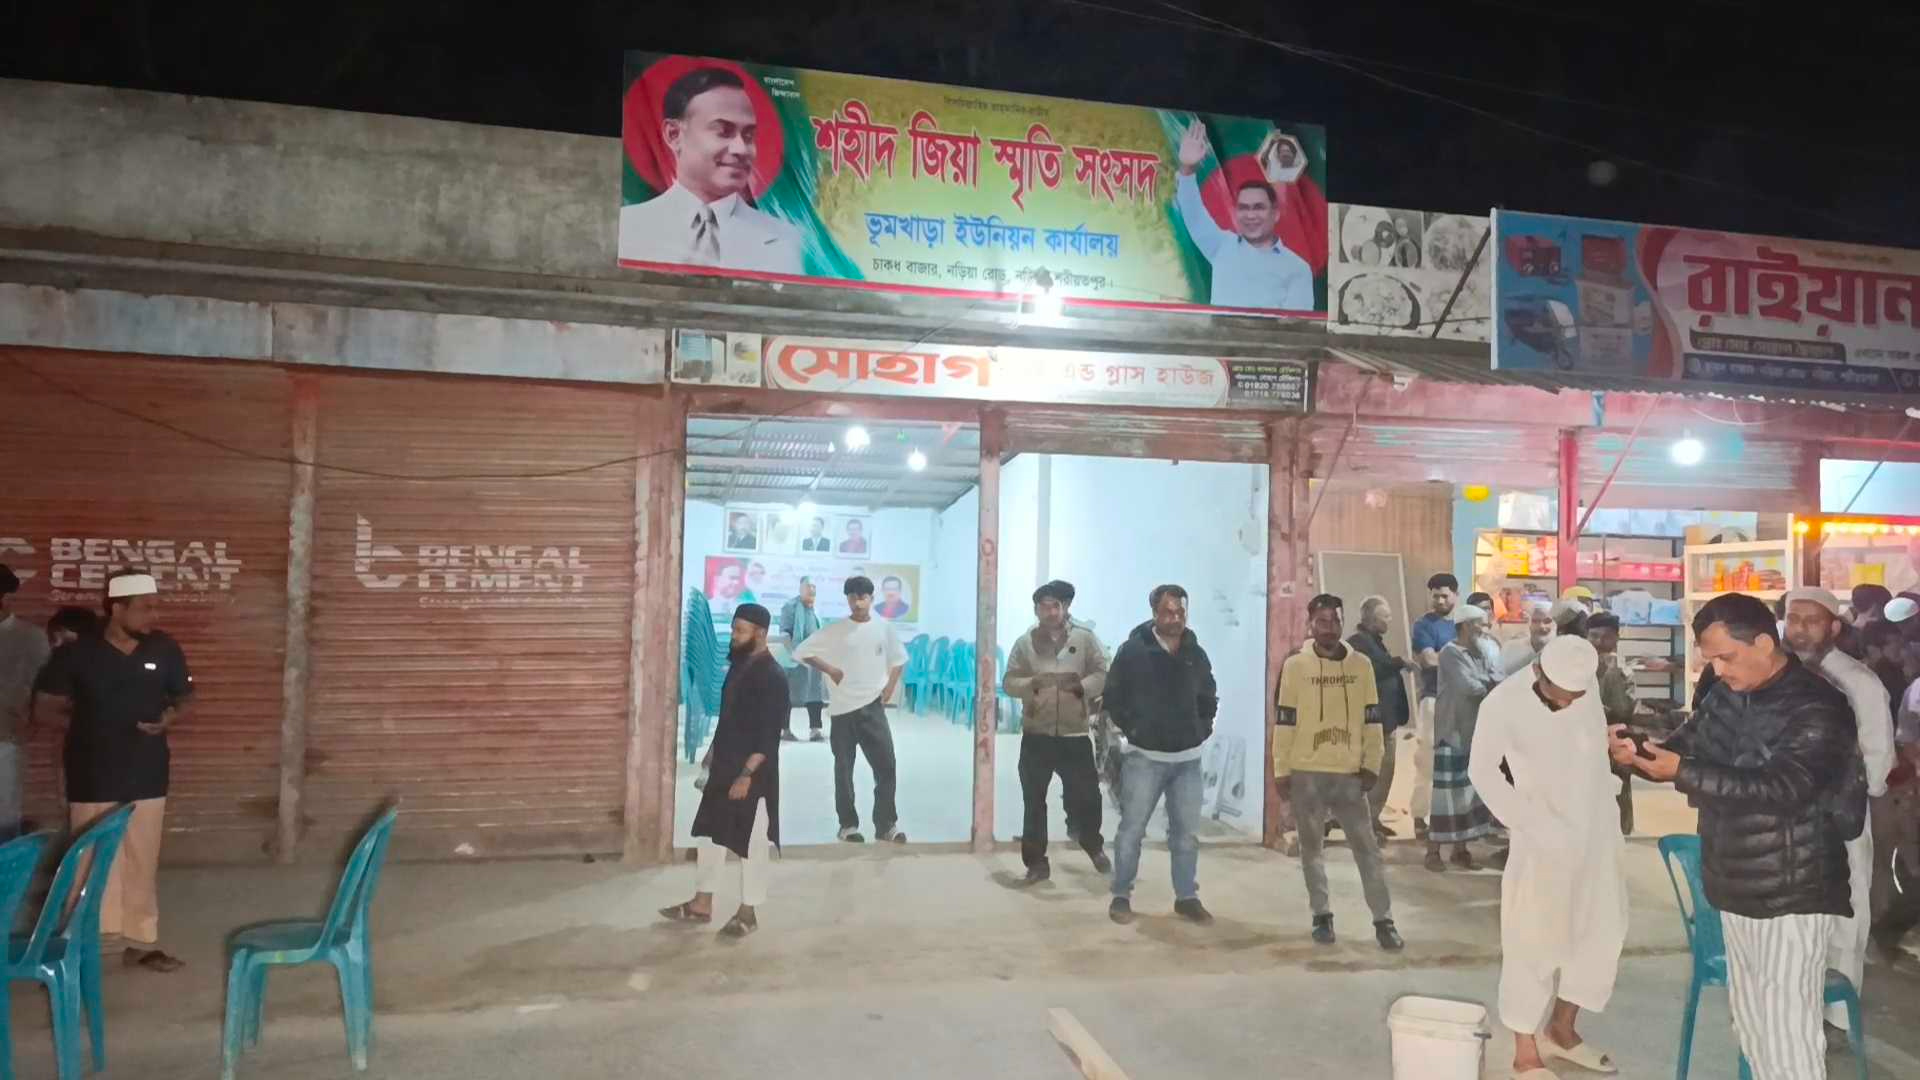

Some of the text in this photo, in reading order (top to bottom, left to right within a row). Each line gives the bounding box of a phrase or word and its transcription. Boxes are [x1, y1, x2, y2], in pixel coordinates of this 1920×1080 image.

[811, 100, 1160, 213] শহীদ জিয়া স্মৃতি সংসদ
[953, 214, 1036, 252] ইউনিয়ন
[1043, 224, 1120, 258] কার্যালয়
[777, 345, 991, 387] সোহাগ
[50, 537, 242, 565] BENGAL
[418, 544, 591, 569] BENGAL
[417, 568, 585, 593] CEMENT
